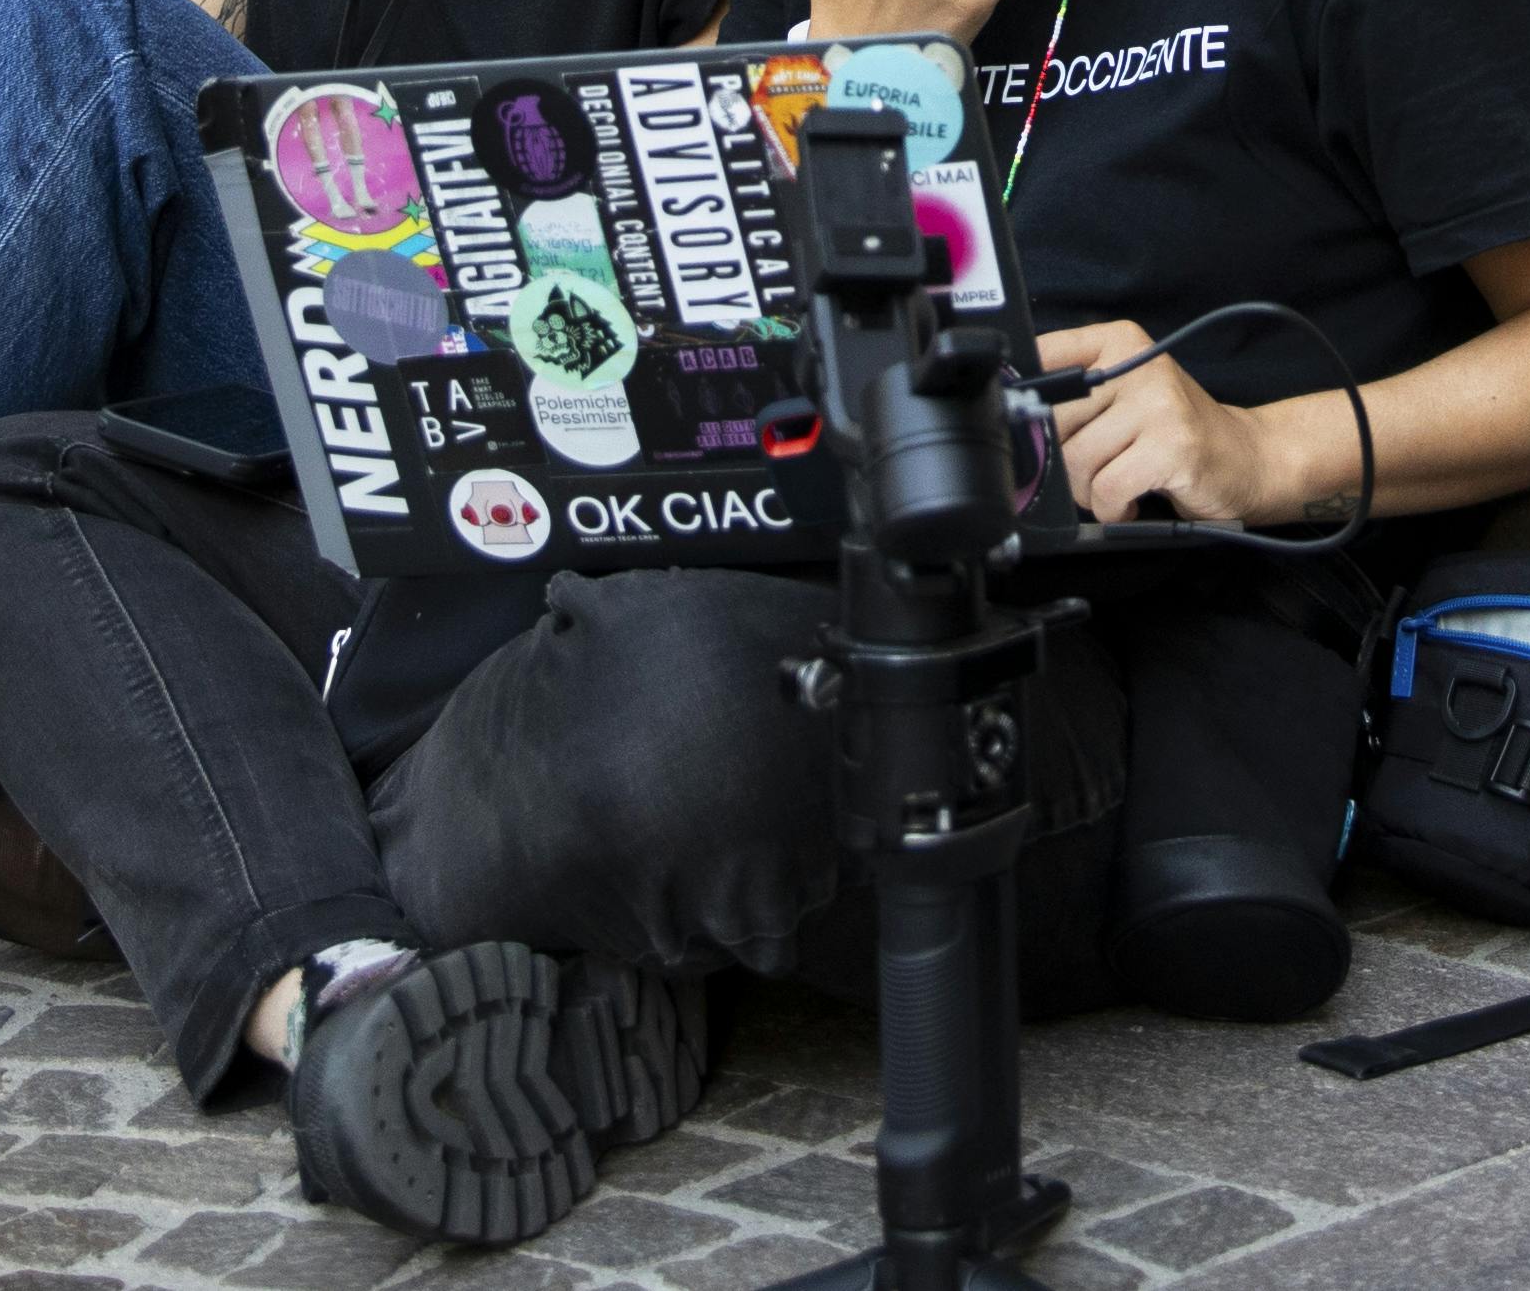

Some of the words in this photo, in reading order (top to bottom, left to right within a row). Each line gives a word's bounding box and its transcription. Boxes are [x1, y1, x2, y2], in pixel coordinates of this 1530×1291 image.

[973, 63, 1030, 104] TE
[1040, 24, 1229, 96] OCCIDENTE
[844, 80, 921, 107] EUFORIA
[908, 121, 948, 139] BILE
[710, 74, 796, 302] PLITICAL
[937, 167, 975, 184] MAI
[629, 77, 754, 309] ADVISORY
[614, 219, 667, 310] CONTENT
[953, 289, 999, 305] MPRE
[535, 393, 629, 411] Polemiche
[568, 493, 653, 535] OK
